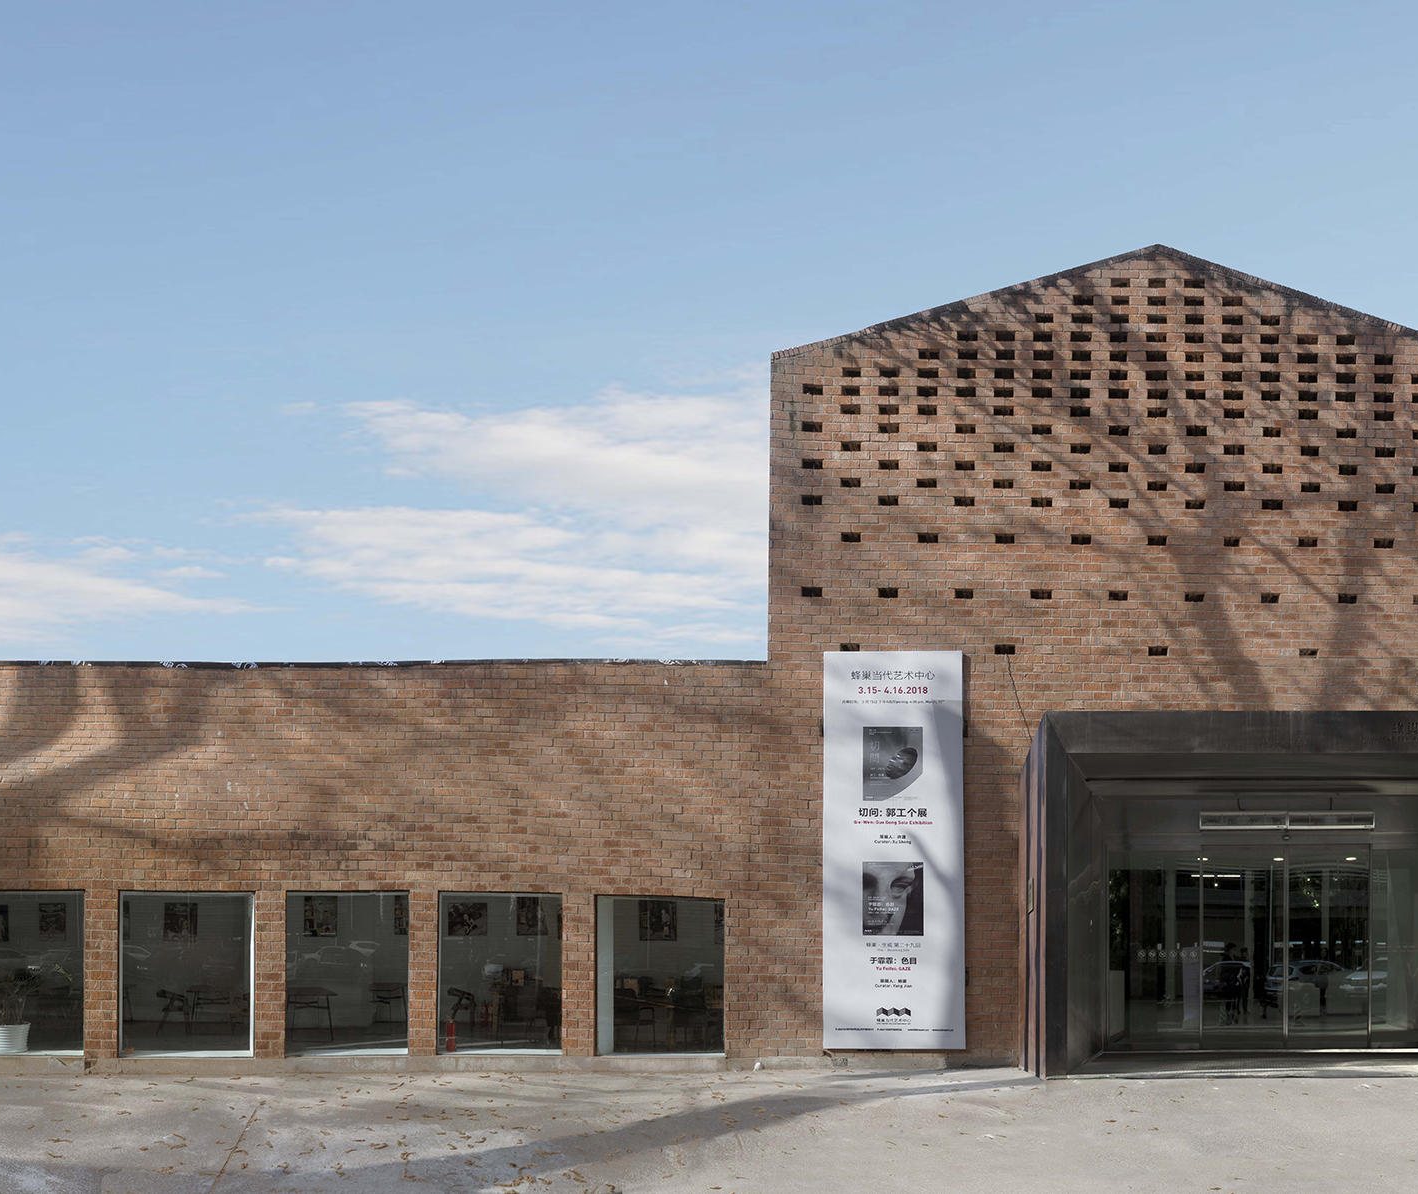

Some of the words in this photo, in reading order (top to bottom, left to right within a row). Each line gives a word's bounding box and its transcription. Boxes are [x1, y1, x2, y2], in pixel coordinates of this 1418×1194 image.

[851, 670, 935, 681] 蜂巢当代艺术中心
[884, 686, 928, 694] 4.16.2018
